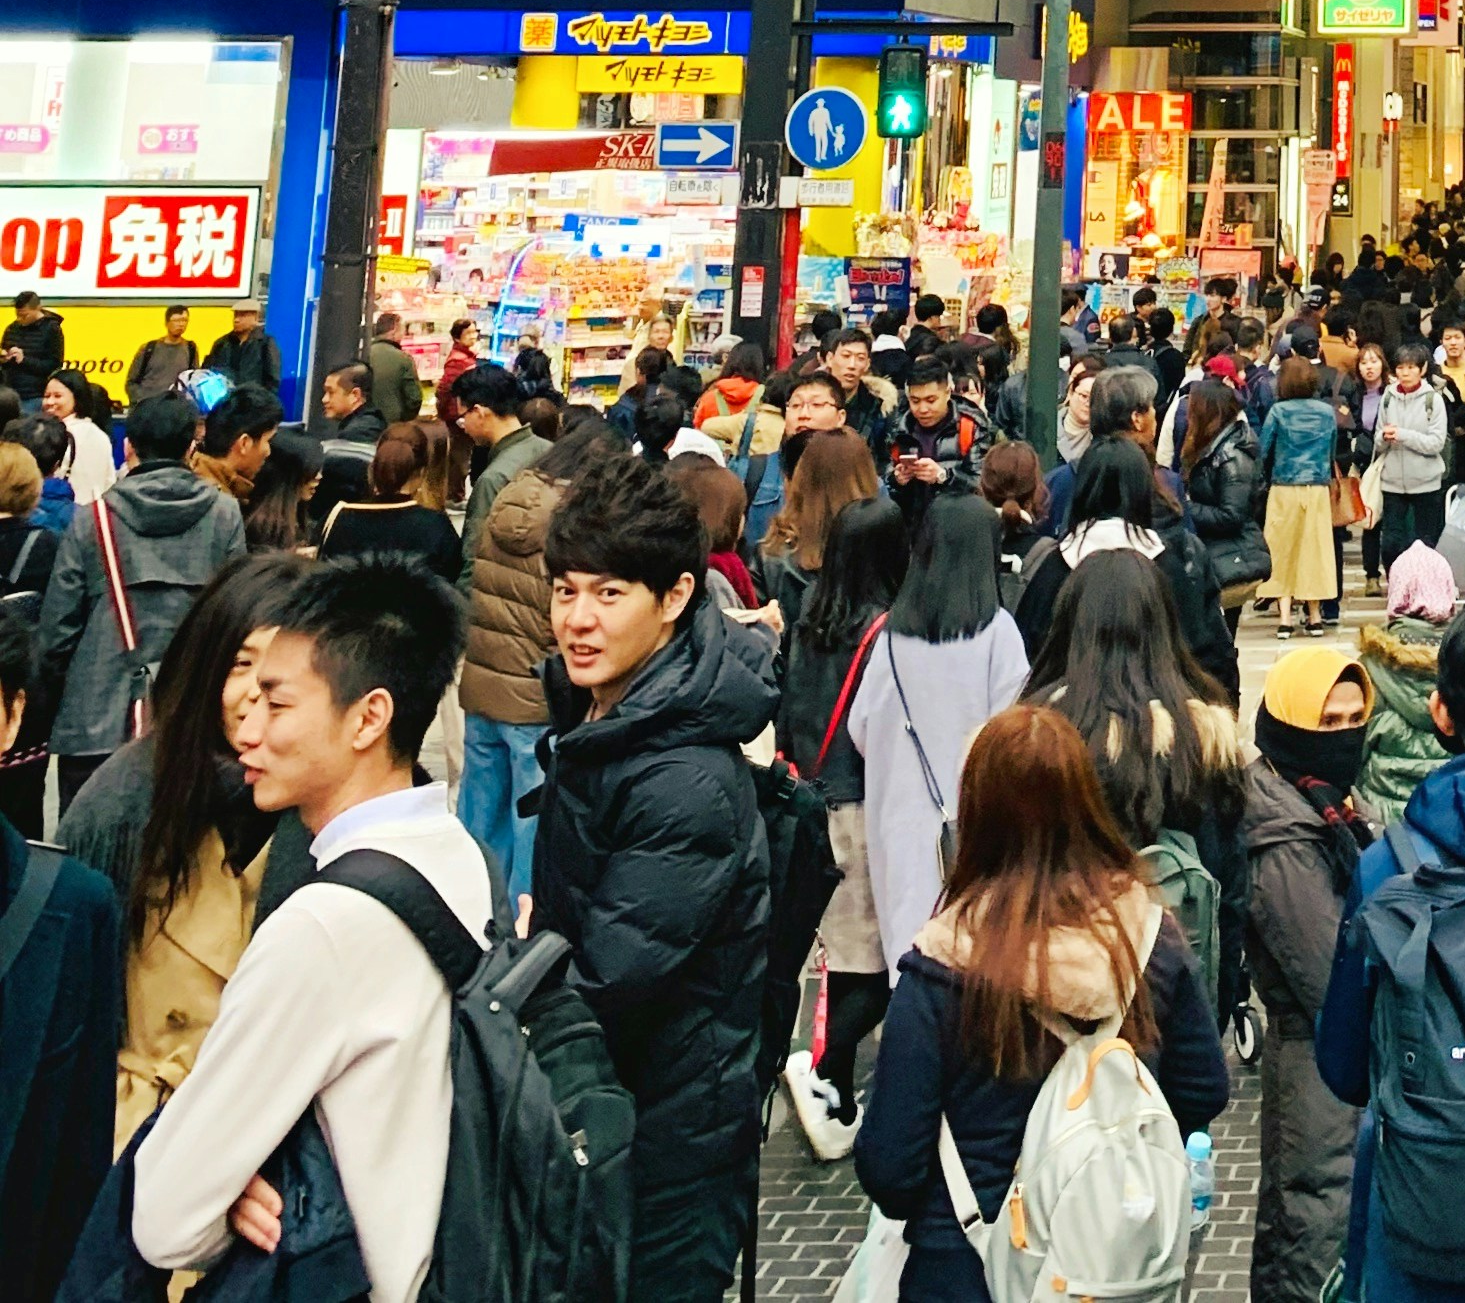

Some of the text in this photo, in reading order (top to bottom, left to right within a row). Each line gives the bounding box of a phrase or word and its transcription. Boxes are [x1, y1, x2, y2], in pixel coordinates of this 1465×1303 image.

[523, 13, 712, 50] 薬 マツモトキヨシ
[604, 59, 717, 89] マツモトキヨシ
[1332, 194, 1349, 208] 24
[105, 203, 239, 279] 免税
